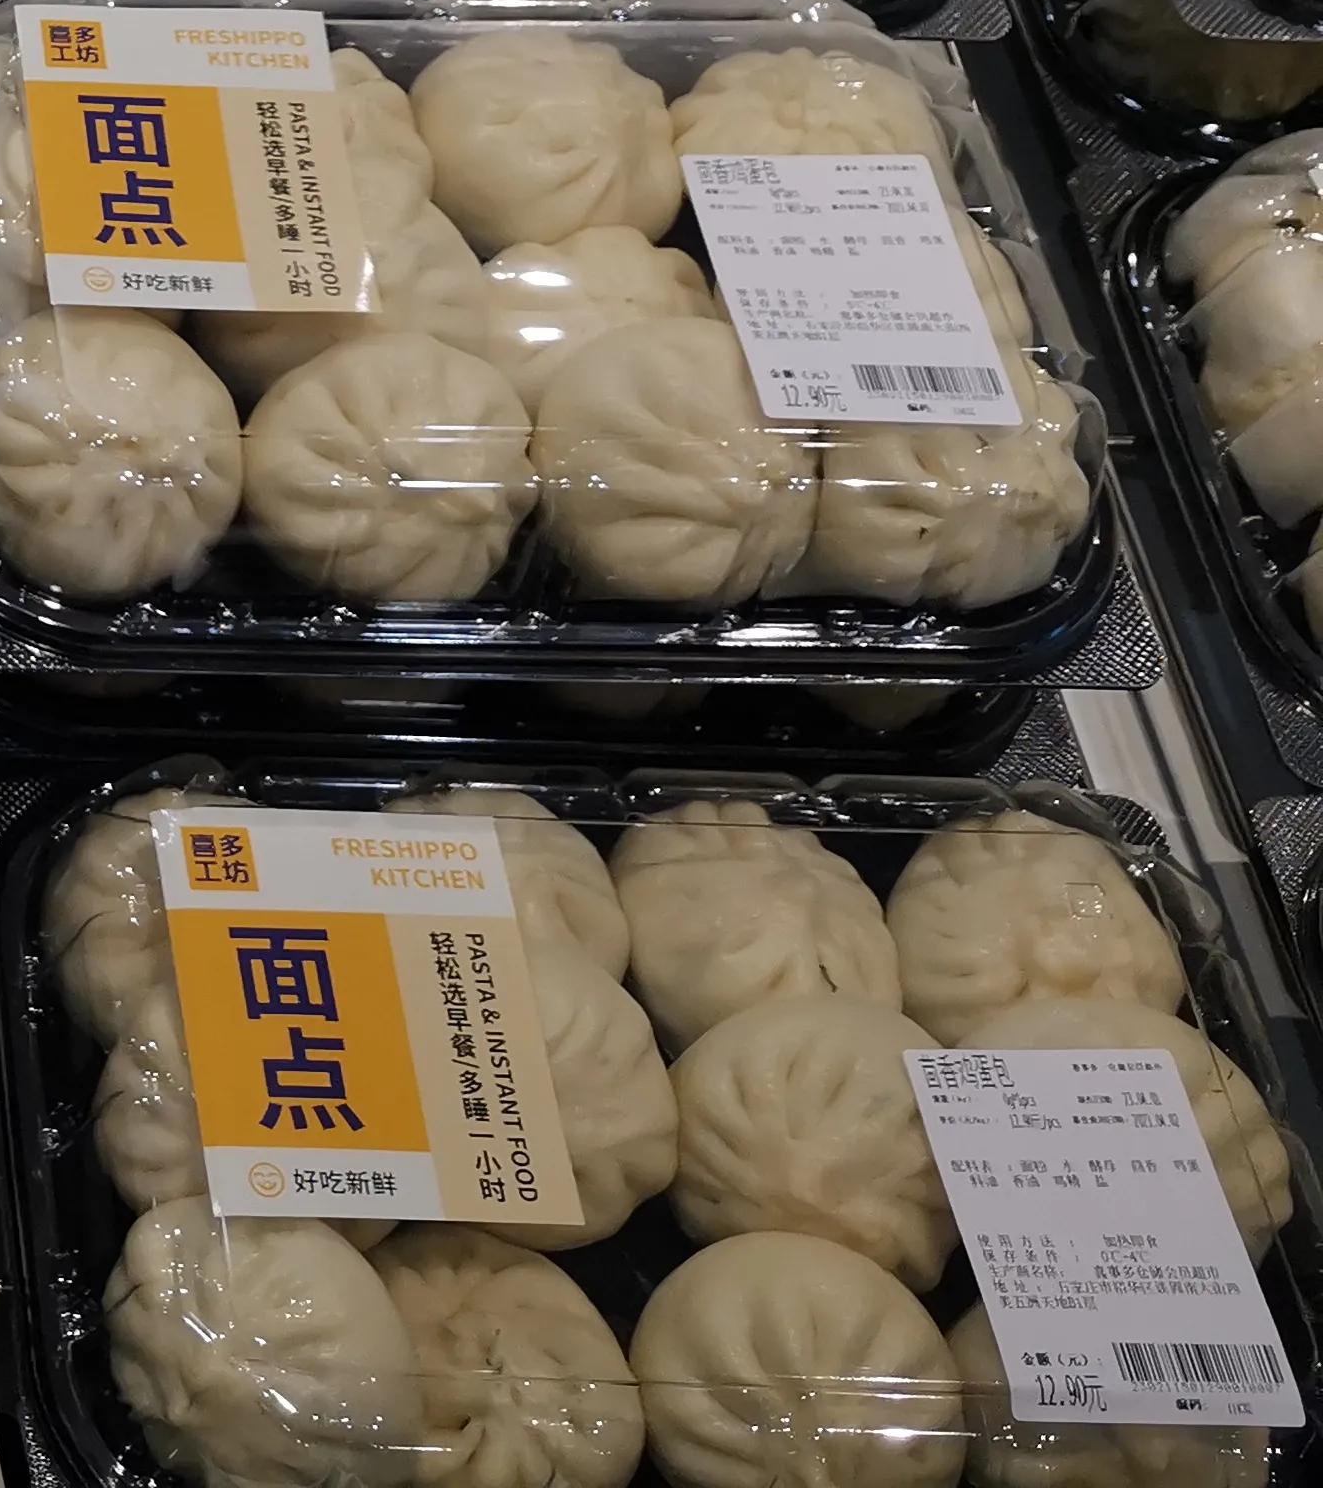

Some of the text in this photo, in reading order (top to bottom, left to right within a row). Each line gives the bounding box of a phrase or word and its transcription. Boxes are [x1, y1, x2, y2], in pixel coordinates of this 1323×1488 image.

[174, 29, 306, 47] FRESHIPPO
[208, 52, 310, 69] KITCHEN
[287, 102, 312, 157] PASTA
[78, 95, 187, 246] 面点
[301, 175, 331, 248] INSTANT
[315, 251, 342, 297] FOOD
[190, 834, 244, 857] 喜多
[331, 837, 477, 860] FRESHIPPO
[195, 860, 250, 884] 工坊
[371, 868, 486, 890] KITCHEN
[228, 927, 365, 1132] 面点
[429, 931, 506, 1203] 轻松选早餐/多睡一小时
[465, 933, 497, 1003] PASTA
[485, 1030, 524, 1132] INSTANT
[507, 1136, 539, 1203] FOOD
[293, 1169, 397, 1197] 好吃新鲜
[1035, 1374, 1107, 1412] 12.90元
